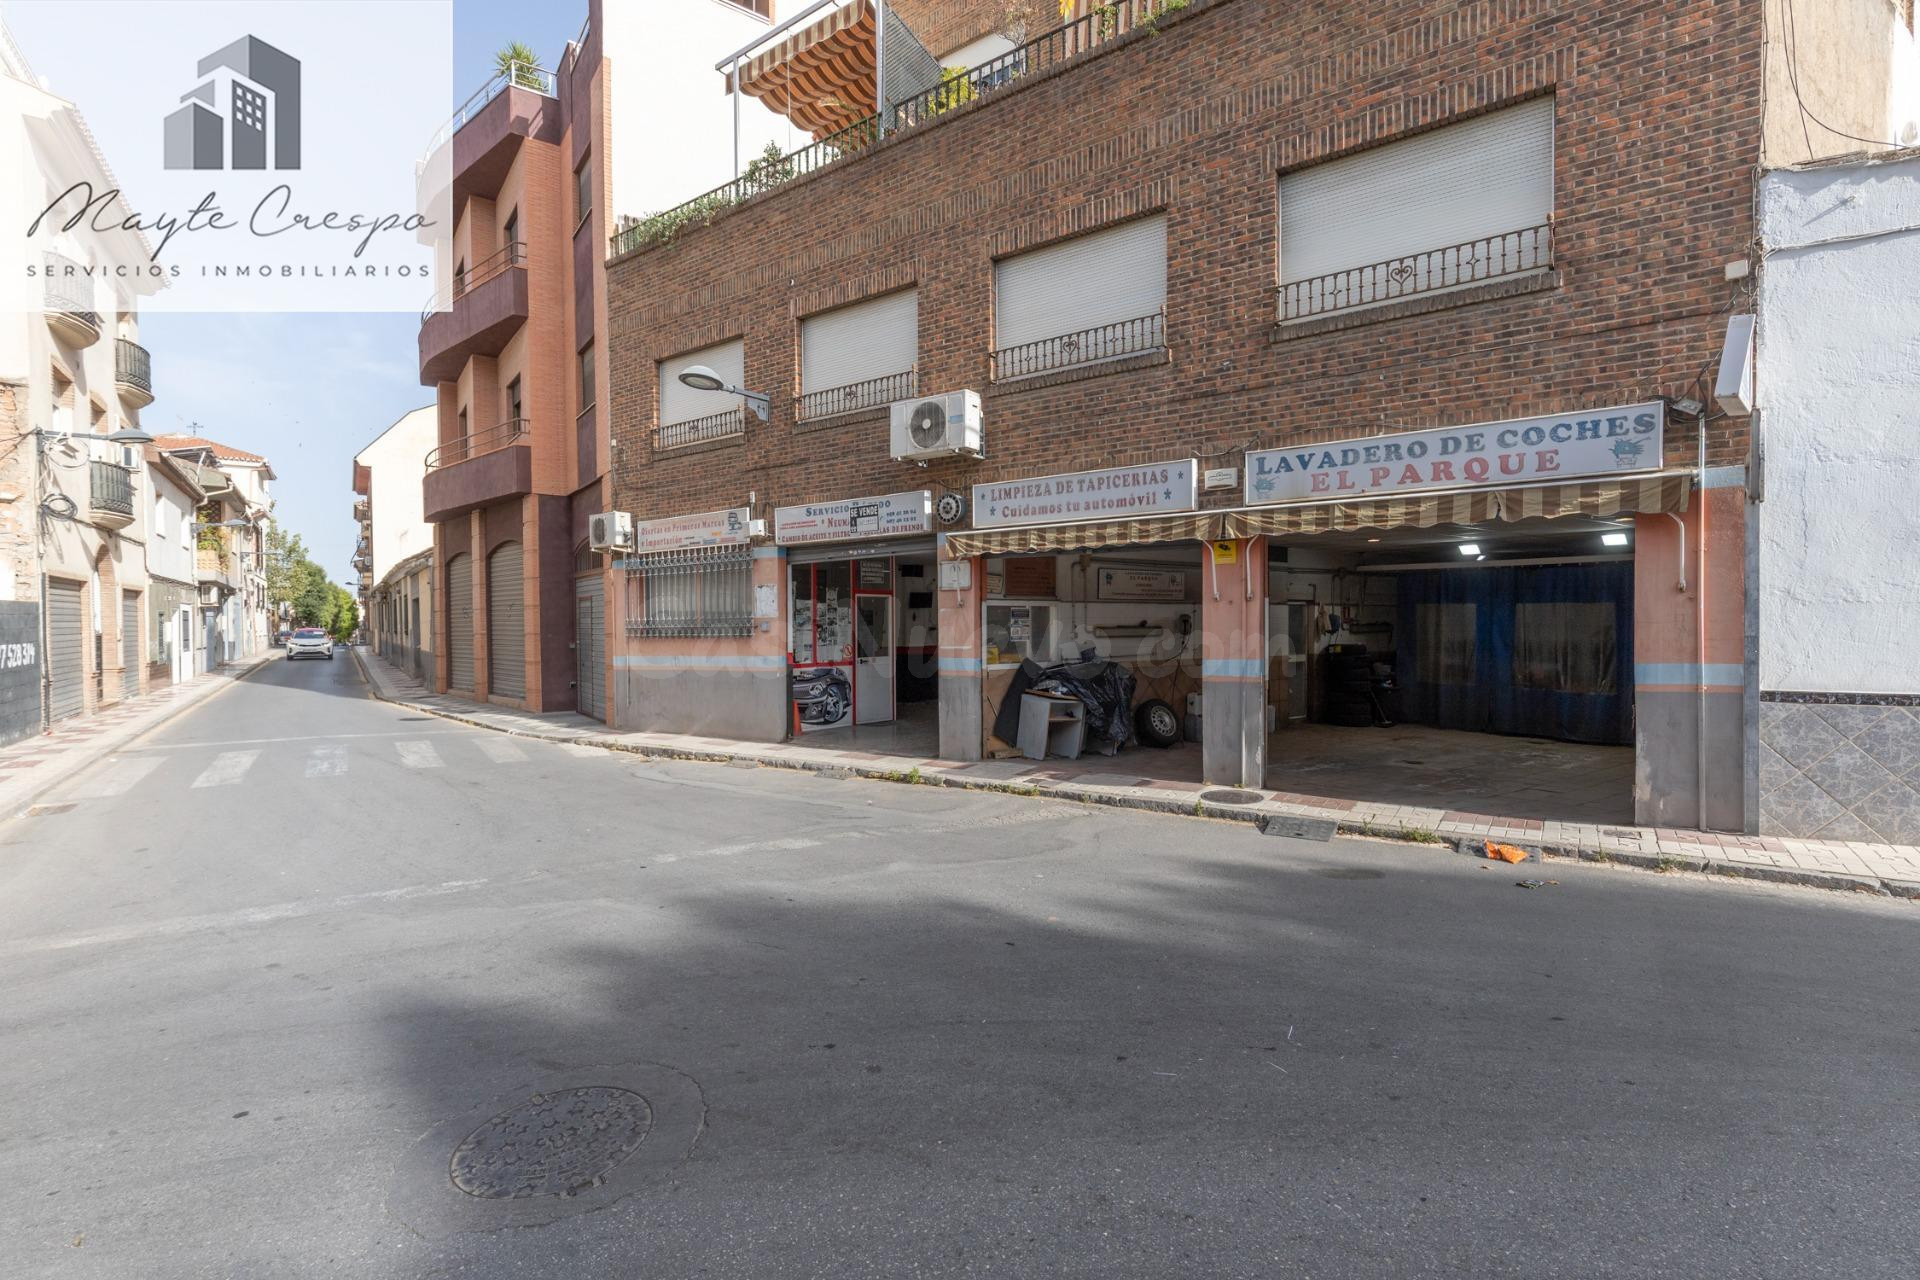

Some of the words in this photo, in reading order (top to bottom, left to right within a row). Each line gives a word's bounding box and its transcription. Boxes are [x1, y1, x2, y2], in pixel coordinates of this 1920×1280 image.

[1256, 440, 1428, 476] LAVADERO
[1440, 433, 1485, 456] DE
[1497, 413, 1656, 448] COCHES
[991, 482, 1050, 502] LIMPIEZA
[1056, 480, 1073, 494] DE
[1077, 468, 1168, 492] TAPICERIAS
[1311, 471, 1355, 492] EL
[1370, 449, 1560, 487] PARQUE
[851, 508, 858, 518] SE
[859, 506, 878, 516] VENDE
[1002, 503, 1062, 518] Cuidamos
[1066, 501, 1080, 512] tu
[1084, 492, 1156, 510] automóvil
